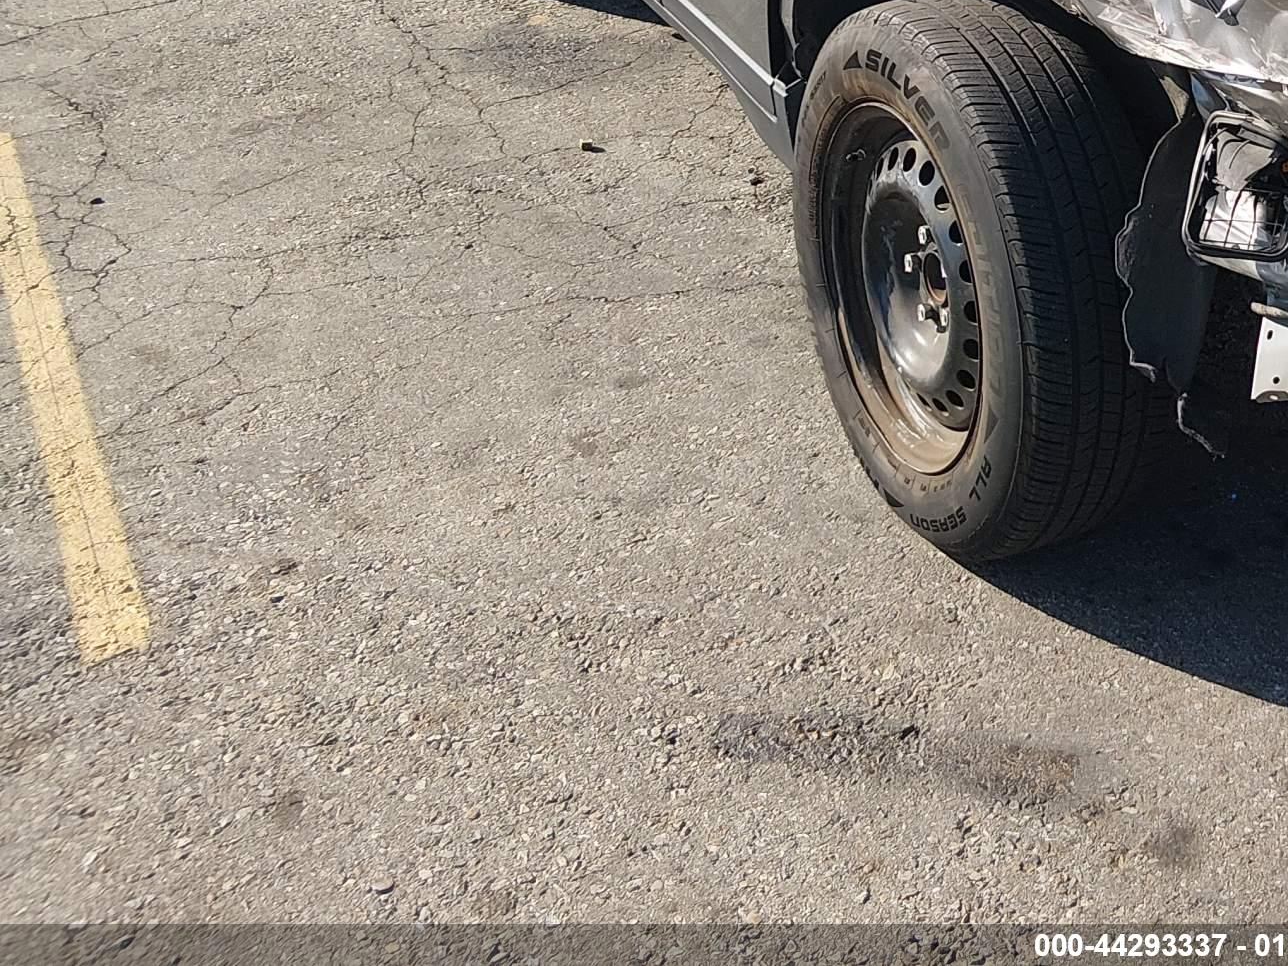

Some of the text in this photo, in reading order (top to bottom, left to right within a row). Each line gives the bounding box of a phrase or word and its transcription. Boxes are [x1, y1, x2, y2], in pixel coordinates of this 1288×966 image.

[865, 49, 950, 151] SILVER
[969, 456, 992, 502] ALL
[910, 506, 967, 533] SEASON
